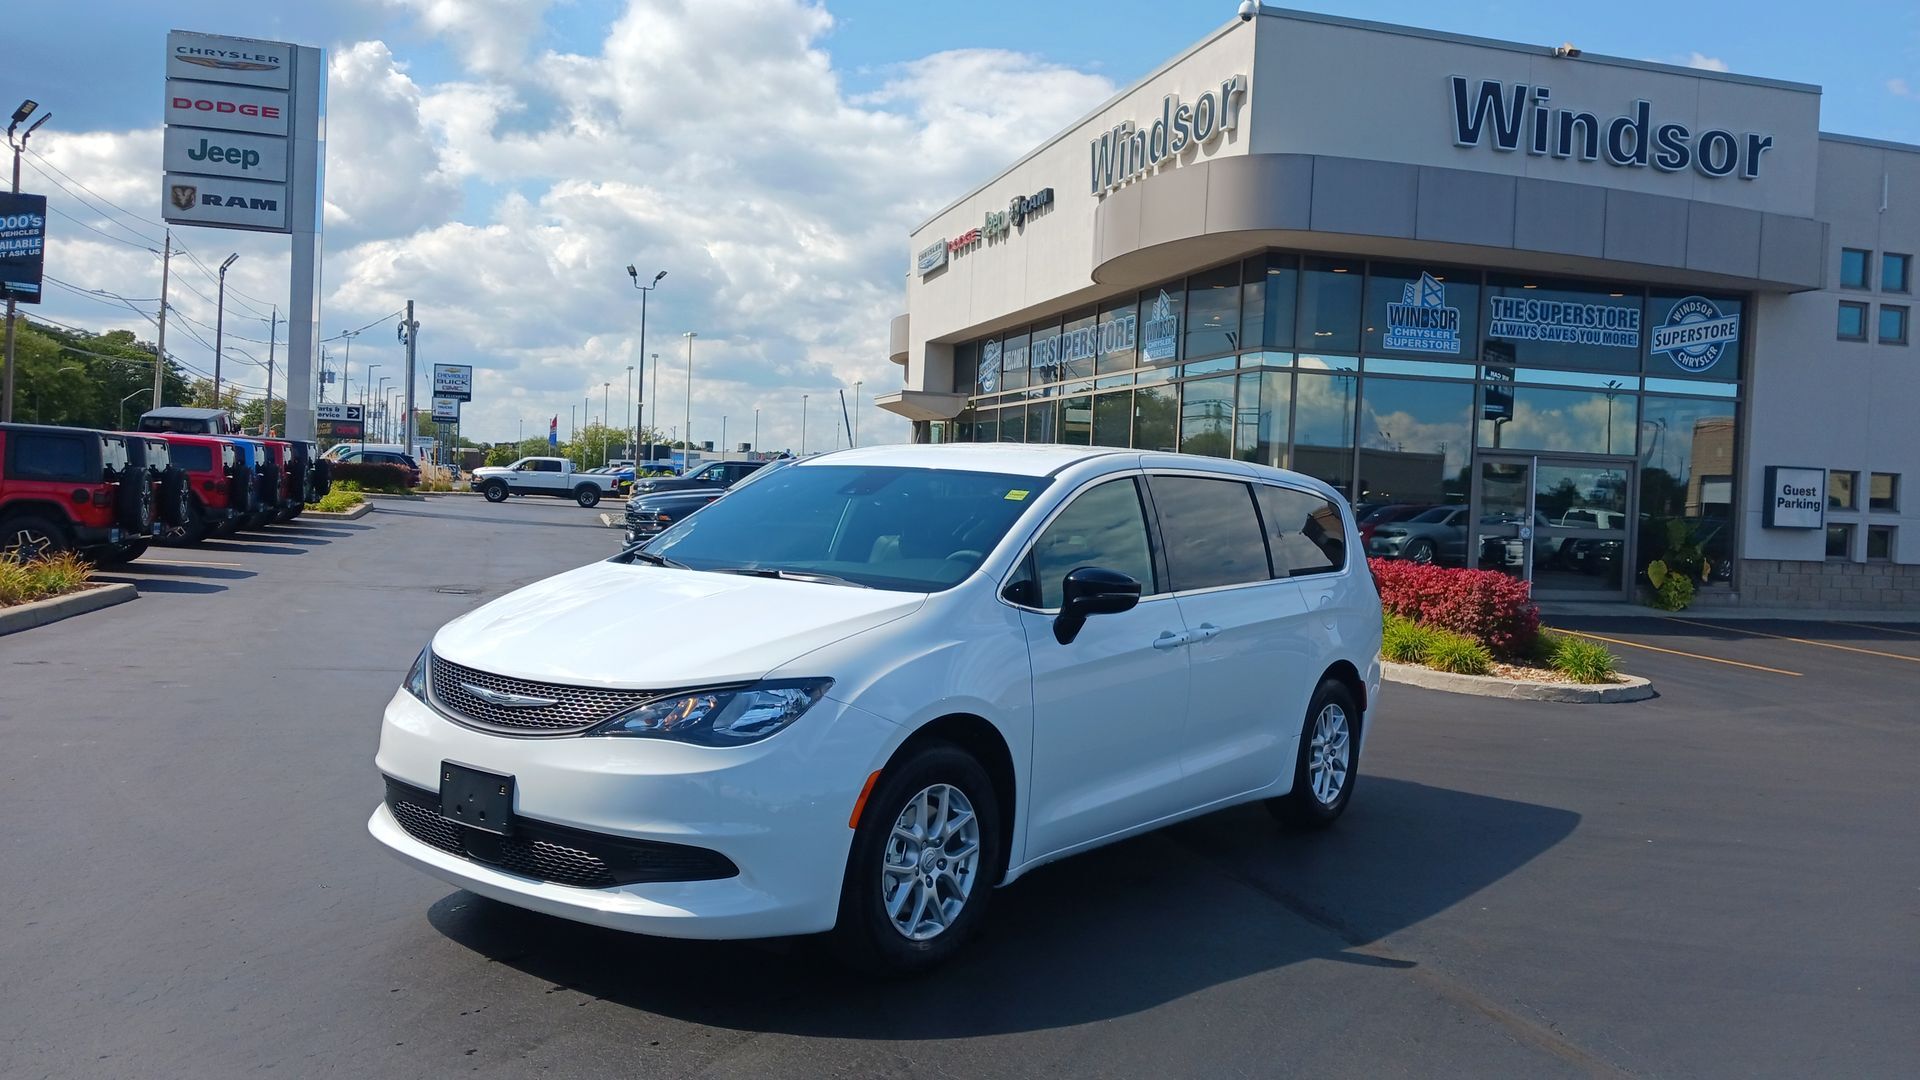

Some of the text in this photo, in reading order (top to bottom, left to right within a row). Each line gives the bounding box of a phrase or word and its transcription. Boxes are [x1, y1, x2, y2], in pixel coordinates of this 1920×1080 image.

[176, 46, 279, 63] CHRYSLER
[173, 97, 280, 119] DODGE
[1091, 75, 1244, 196] Windsor
[1451, 76, 1774, 178] Windsor
[187, 138, 260, 170] Jeep
[202, 193, 277, 211] RAM
[1020, 187, 1050, 214] RAM
[1, 229, 40, 238] VEHICLES
[948, 229, 977, 253] DODGE
[9, 249, 26, 257] ASK
[28, 248, 41, 256] US
[918, 242, 943, 262] CHRYSLER
[1389, 305, 1457, 330] WINDSOR
[1492, 298, 1639, 330] THE SUPERSTORE
[1672, 302, 1713, 322] WINDSOR
[1032, 315, 1135, 367] THE SUPERSTORE
[1386, 337, 1457, 350] SUPERSTORE
[1394, 327, 1450, 340] CHRYSLER
[1491, 322, 1638, 346] ALWAYS SAVES YOU MORE!
[1655, 322, 1736, 347] SUPERSTORE
[1677, 345, 1718, 367] CHRYSLER
[1783, 484, 1817, 497] Guest
[1777, 497, 1821, 512] Parking
